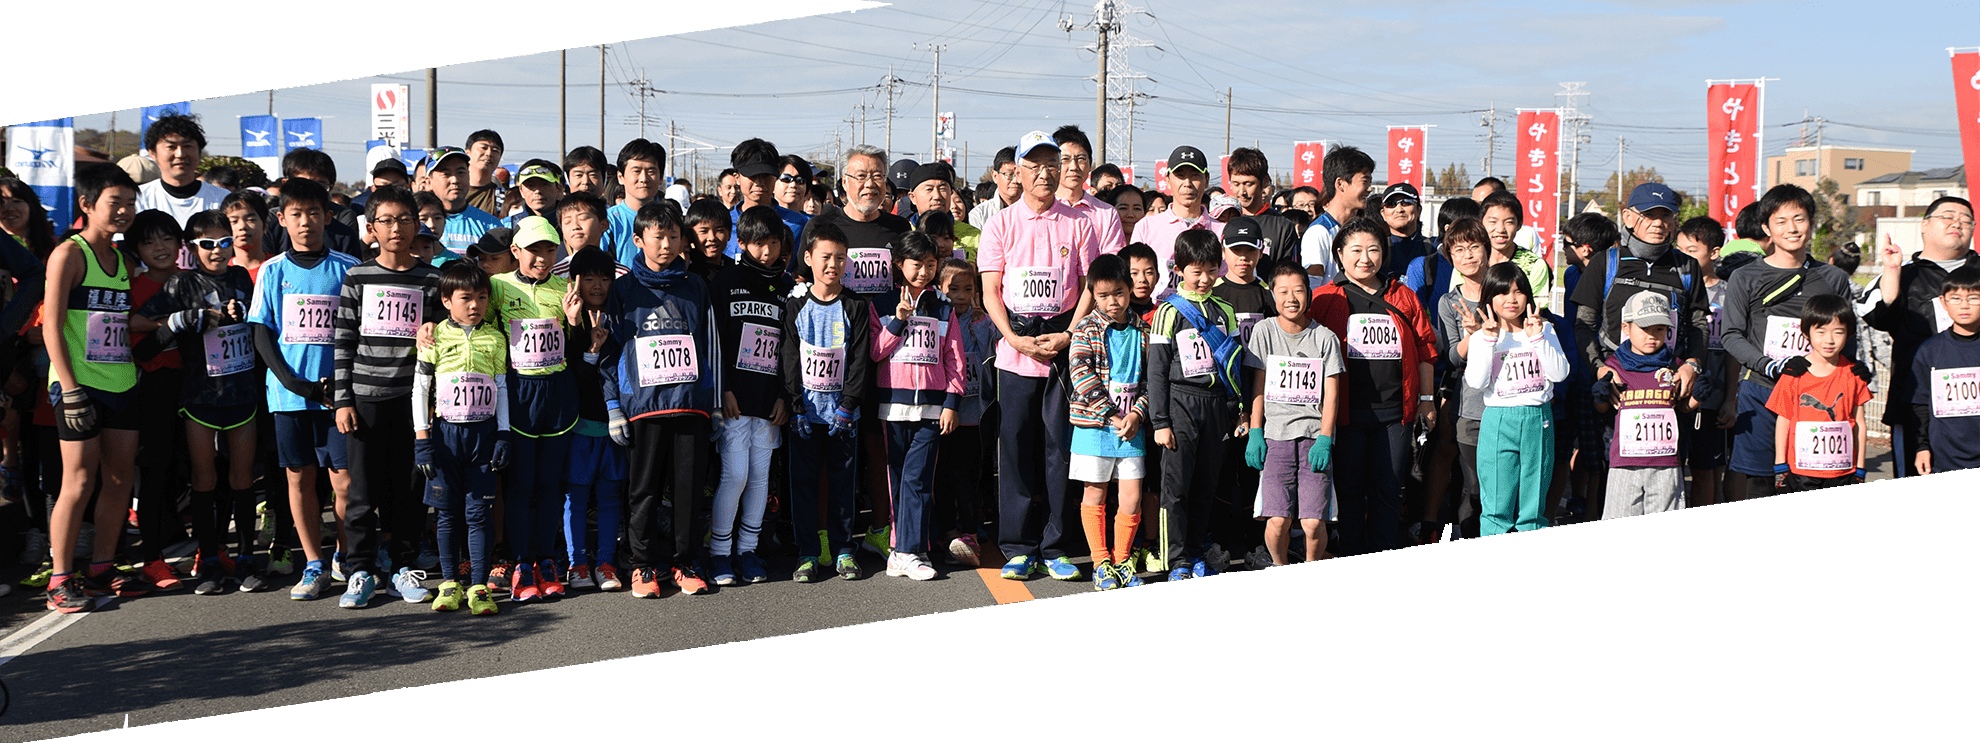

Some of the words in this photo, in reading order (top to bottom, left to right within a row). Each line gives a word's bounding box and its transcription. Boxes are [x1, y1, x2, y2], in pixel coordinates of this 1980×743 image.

[859, 251, 881, 259] Sammy
[853, 260, 889, 279] 20076
[1028, 269, 1052, 278] Sammy
[386, 290, 412, 300] Sammy
[1023, 279, 1058, 298] 20067
[306, 298, 332, 307] Sammy
[733, 302, 773, 317] SPARKS
[299, 308, 338, 329] 21226
[377, 300, 417, 323] 21145
[529, 322, 553, 331] Sammy
[641, 316, 688, 332] adidas
[909, 319, 931, 328] Sammy
[523, 330, 560, 353] 21205
[658, 338, 682, 347] Sammy
[903, 328, 936, 349] 21133
[1362, 326, 1398, 345] 20084
[653, 347, 691, 369] 21078
[812, 349, 835, 359] Sammy
[1509, 349, 1533, 359] Sammy
[805, 357, 840, 378] 21247
[1287, 360, 1311, 370] Sammy
[1504, 358, 1541, 382] 21144
[460, 375, 484, 384] Sammy
[1279, 369, 1317, 390] 21143
[1950, 372, 1976, 380] Sammy
[453, 385, 492, 407] 21170
[1620, 388, 1674, 402] KAWAGO
[1945, 380, 1980, 401] 2100
[1641, 412, 1665, 421] Sammy
[1635, 421, 1673, 441] 21116
[1819, 425, 1843, 434] Sammy
[1812, 434, 1848, 455] 21021
